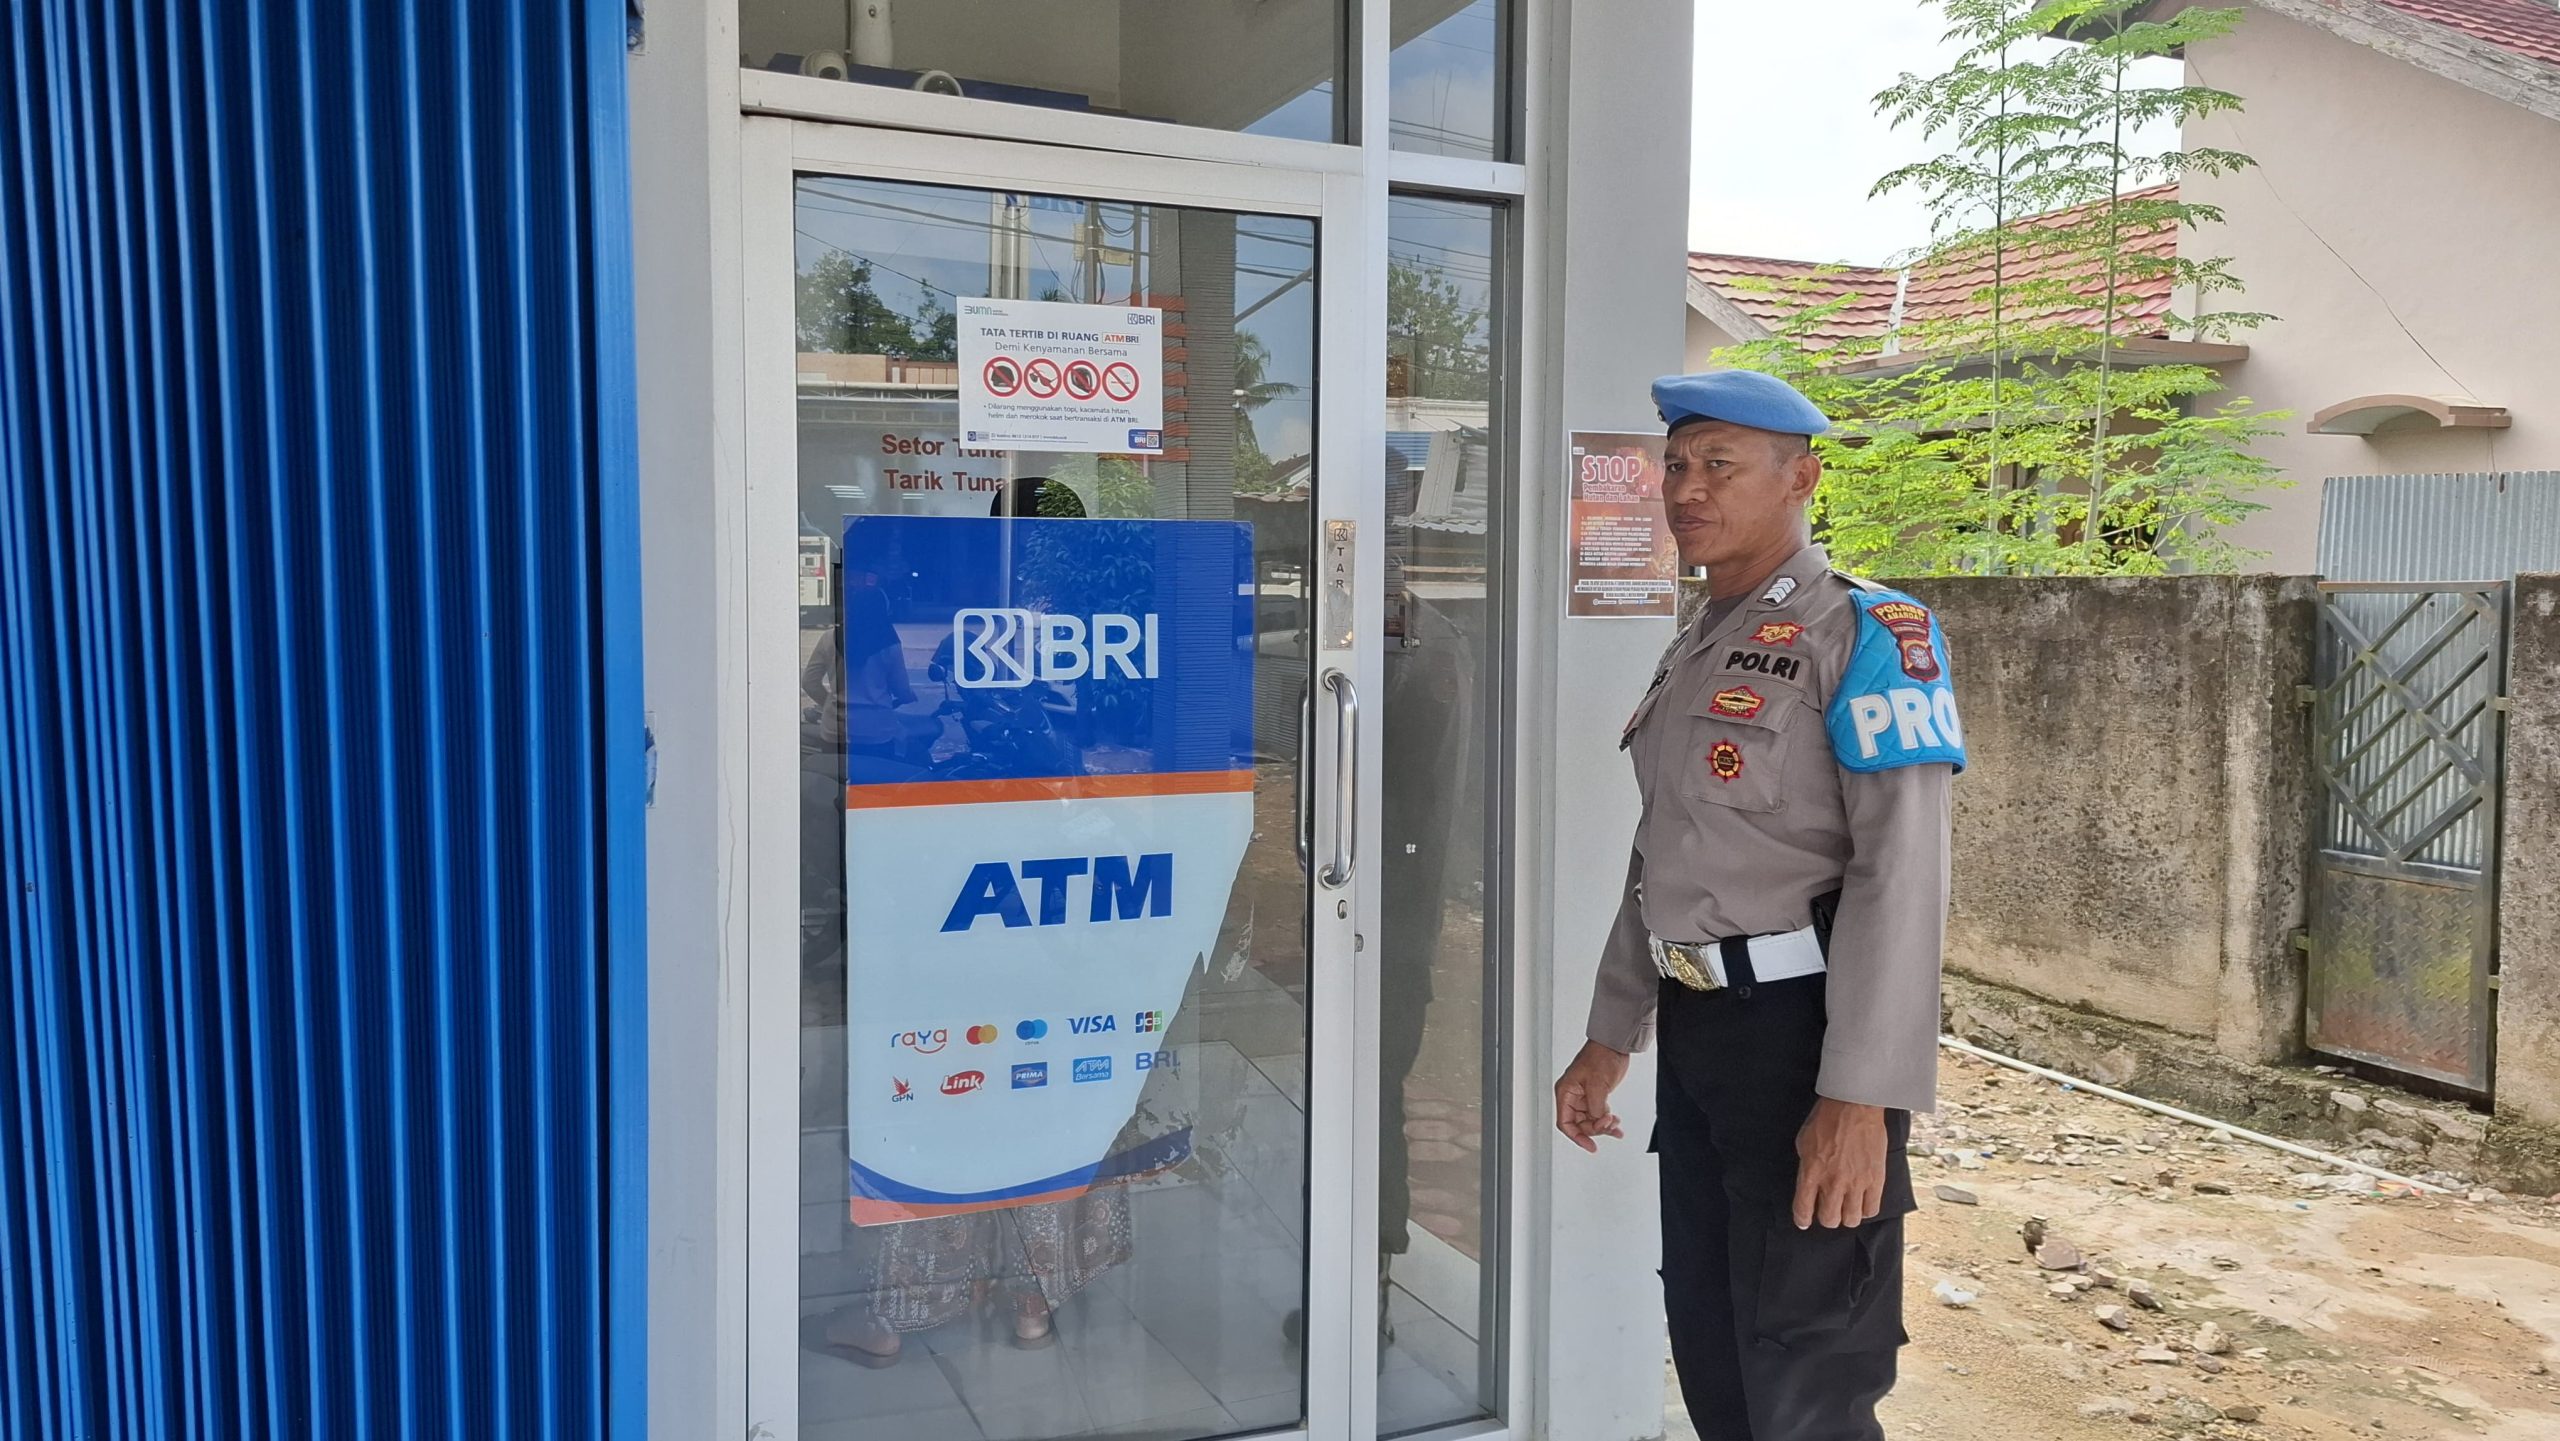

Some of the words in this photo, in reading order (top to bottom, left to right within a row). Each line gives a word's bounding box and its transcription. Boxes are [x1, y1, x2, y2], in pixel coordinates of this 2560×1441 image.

[1138, 315, 1155, 325] BRI
[981, 328, 1006, 337] TATA
[1009, 329, 1043, 339] TERTIB
[1047, 331, 1058, 340] DI
[1062, 332, 1098, 342] RUANG
[995, 342, 1020, 351] Demi
[1023, 343, 1085, 355] Kenyamanan
[1089, 347, 1127, 356] Bersama
[988, 403, 1015, 411] Dilarang
[1017, 404, 1062, 412] menggunakan
[882, 434, 945, 456] Setor
[1582, 455, 1642, 482] STOP
[883, 469, 944, 491] Tarik
[1583, 482, 1626, 492] Pembakaran
[1583, 493, 1604, 502] Hutan
[1605, 494, 1618, 502] dan
[1619, 493, 1640, 503] Lahan
[1041, 613, 1158, 681] BRI
[1725, 650, 1800, 681] POLRI
[940, 853, 1173, 933] ATM
[1067, 1014, 1116, 1034] VISA
[891, 1028, 947, 1048] raya
[1076, 1059, 1109, 1073] ATM
[942, 1074, 982, 1090] Link
[1016, 1071, 1043, 1080] PRIMA
[1076, 1071, 1109, 1081] Bersama
[892, 1093, 914, 1102] GPN
